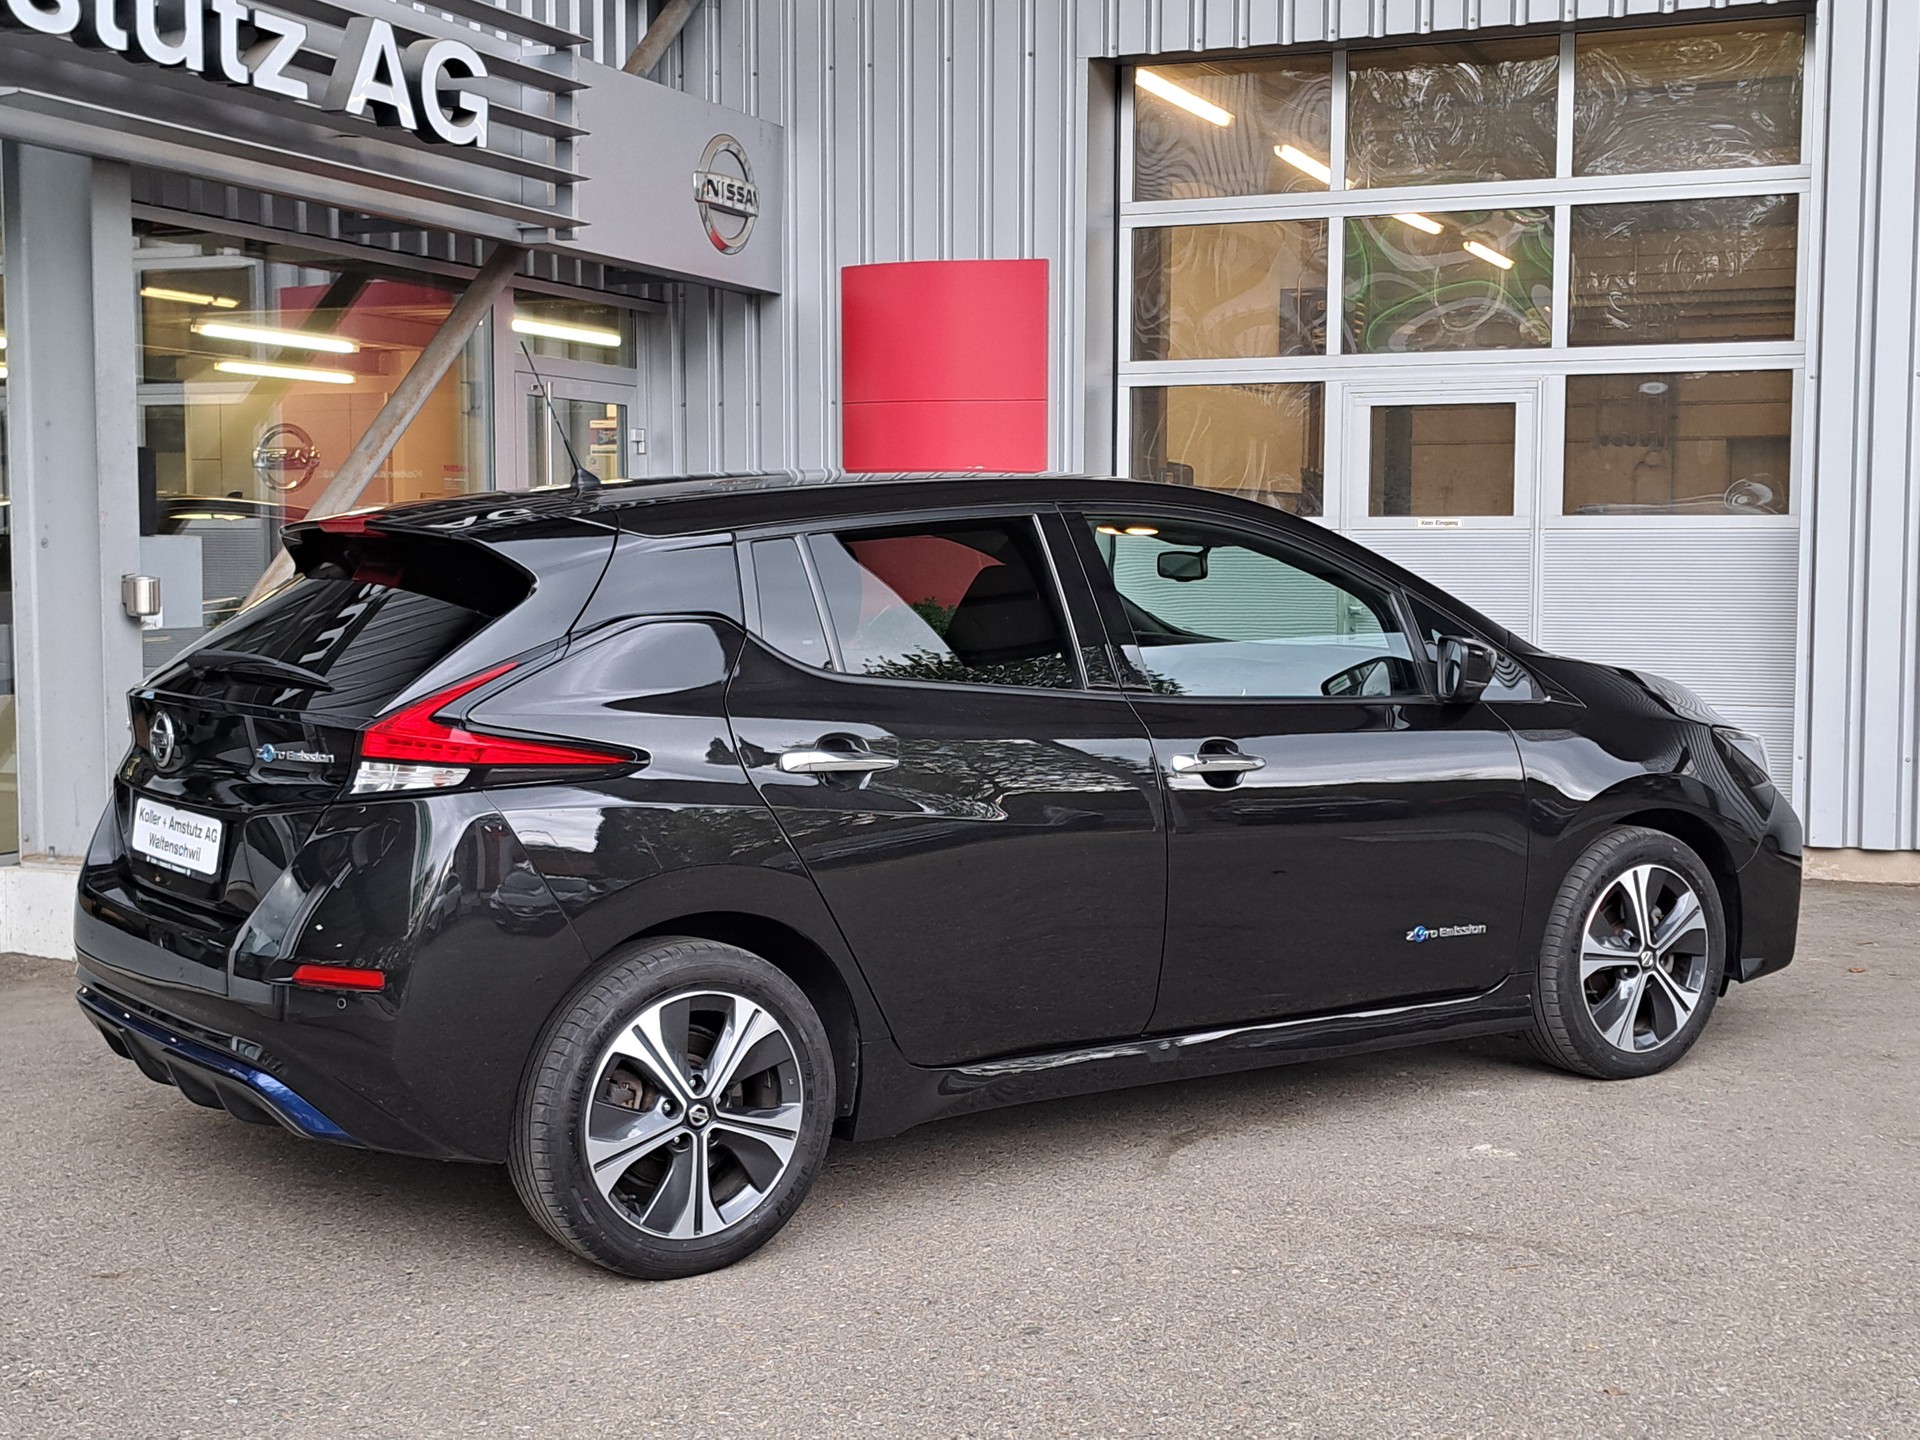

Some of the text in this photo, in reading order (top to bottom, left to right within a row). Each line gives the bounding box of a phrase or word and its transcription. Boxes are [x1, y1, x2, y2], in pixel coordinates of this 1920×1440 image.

[345, 18, 489, 148] AG
[706, 178, 759, 209] NISSAN
[286, 749, 335, 764] Emission
[139, 806, 161, 826] Koller
[168, 816, 203, 839] Amstutz
[204, 826, 218, 843] AG
[148, 832, 202, 862] Waltenschwil
[1439, 924, 1487, 938] Emission
